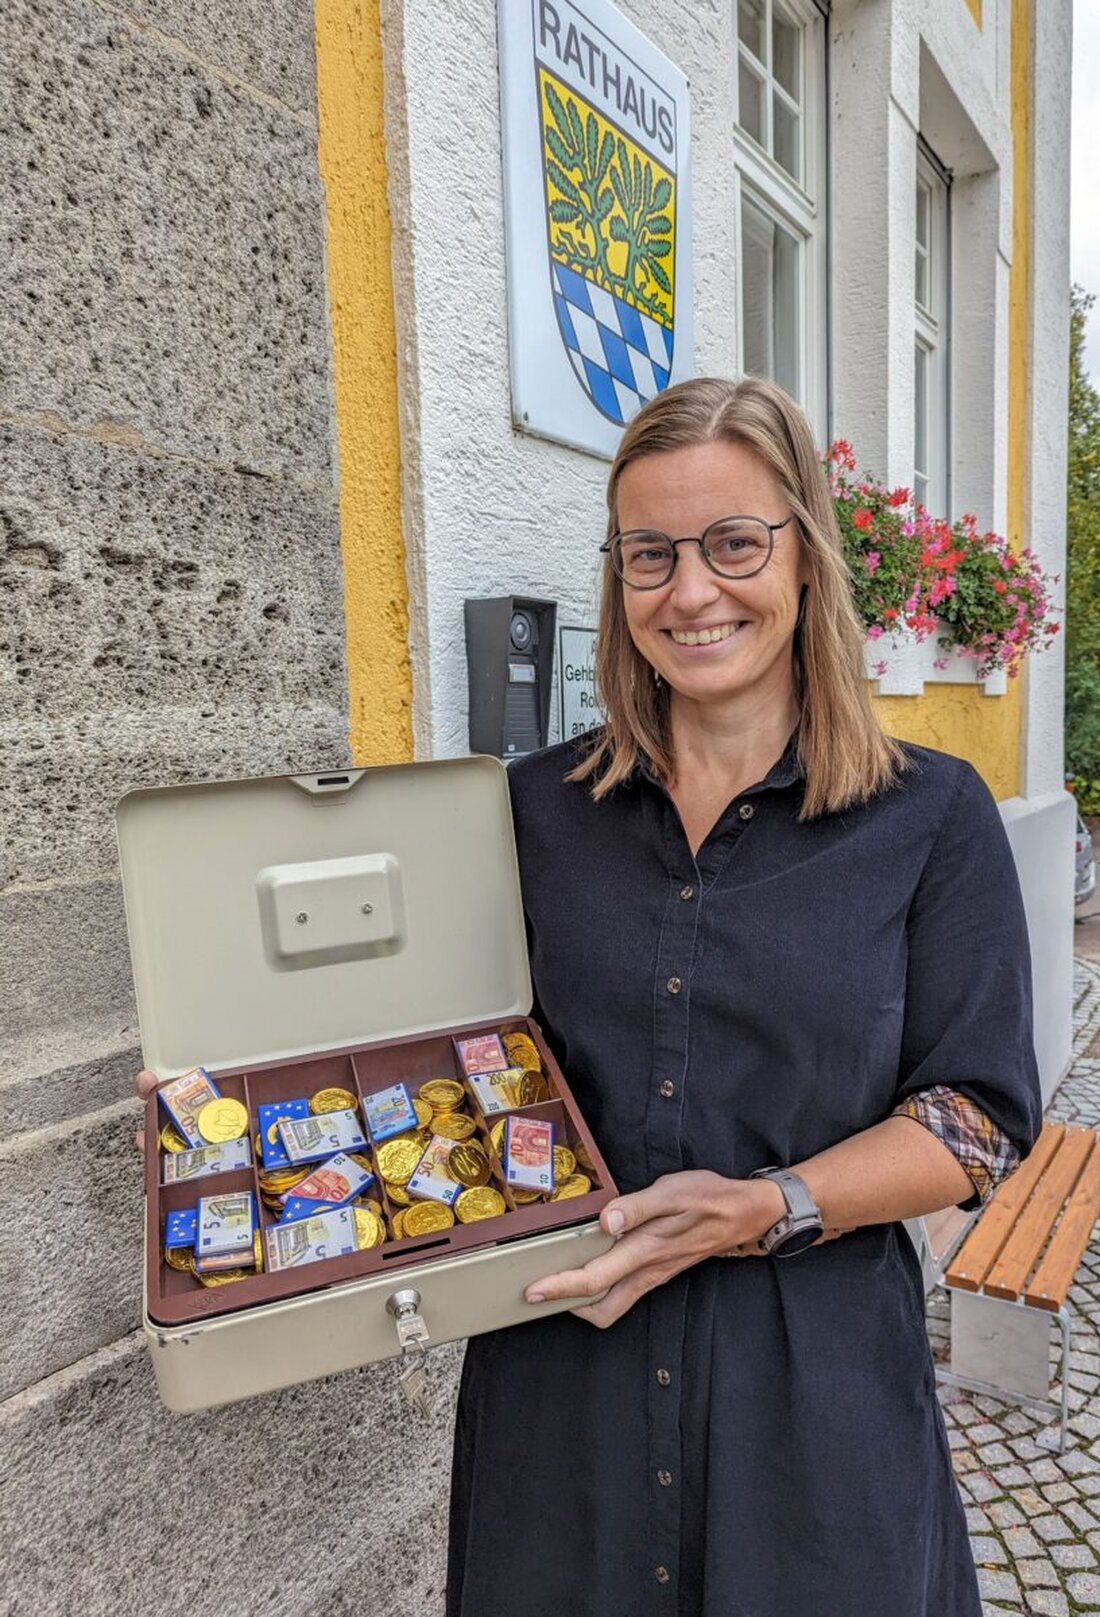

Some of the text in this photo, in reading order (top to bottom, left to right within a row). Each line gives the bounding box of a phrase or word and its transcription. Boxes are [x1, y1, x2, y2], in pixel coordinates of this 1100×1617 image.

[538, 0, 674, 154] RATHAUS
[564, 664, 596, 682] Gehb
[580, 691, 598, 708] Ro
[571, 722, 585, 735] an
[486, 1072, 506, 1086] 200
[329, 1135, 340, 1147] 5
[417, 1161, 434, 1178] 50
[540, 1173, 549, 1184] 10
[203, 1221, 221, 1230] 5
